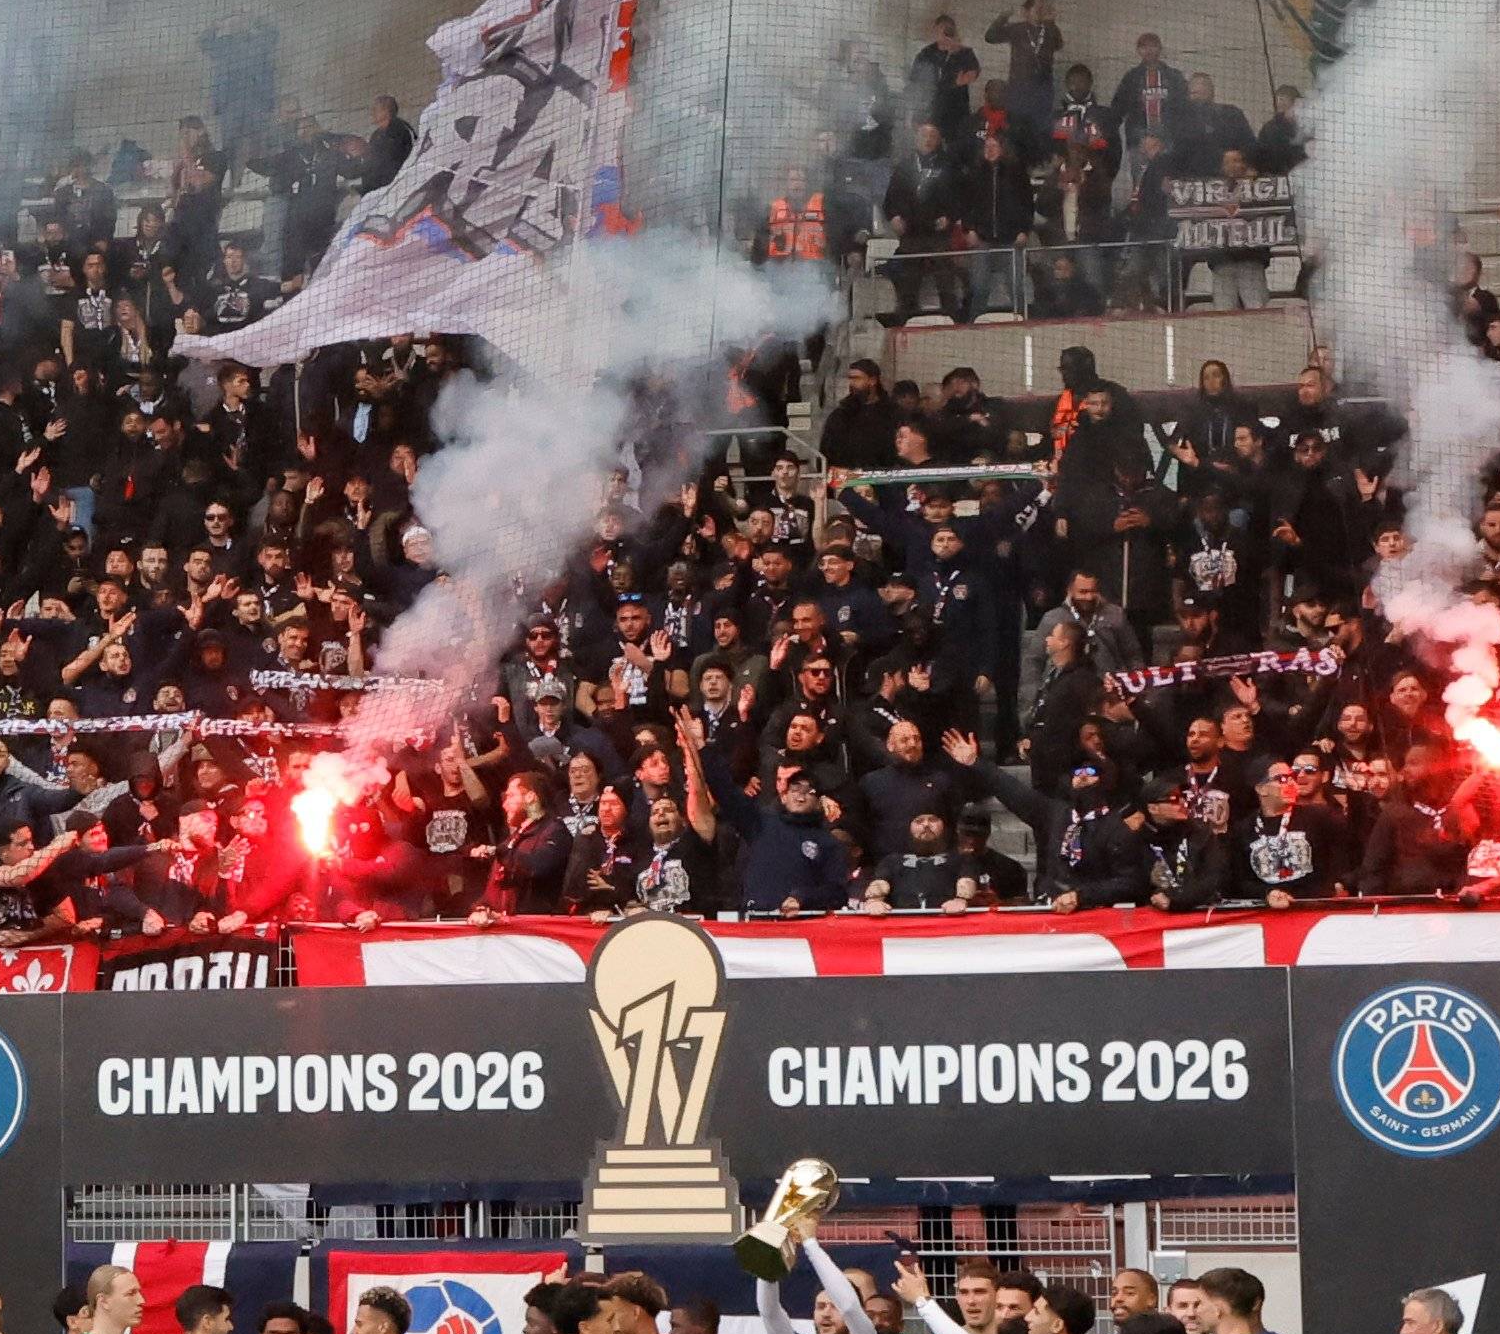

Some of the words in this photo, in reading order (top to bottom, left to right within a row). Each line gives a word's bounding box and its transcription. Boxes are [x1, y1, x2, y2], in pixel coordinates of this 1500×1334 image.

[1251, 647, 1338, 676] RAS
[1364, 994, 1477, 1034] PARIS
[98, 1052, 398, 1117] CHAMPIONS
[408, 1050, 545, 1113] 2026
[768, 1042, 1090, 1108] CHAMPIONS
[1101, 1038, 1250, 1102] 2026
[1368, 1105, 1410, 1134] SAINT
[1420, 1104, 1481, 1138] GERMAIN
